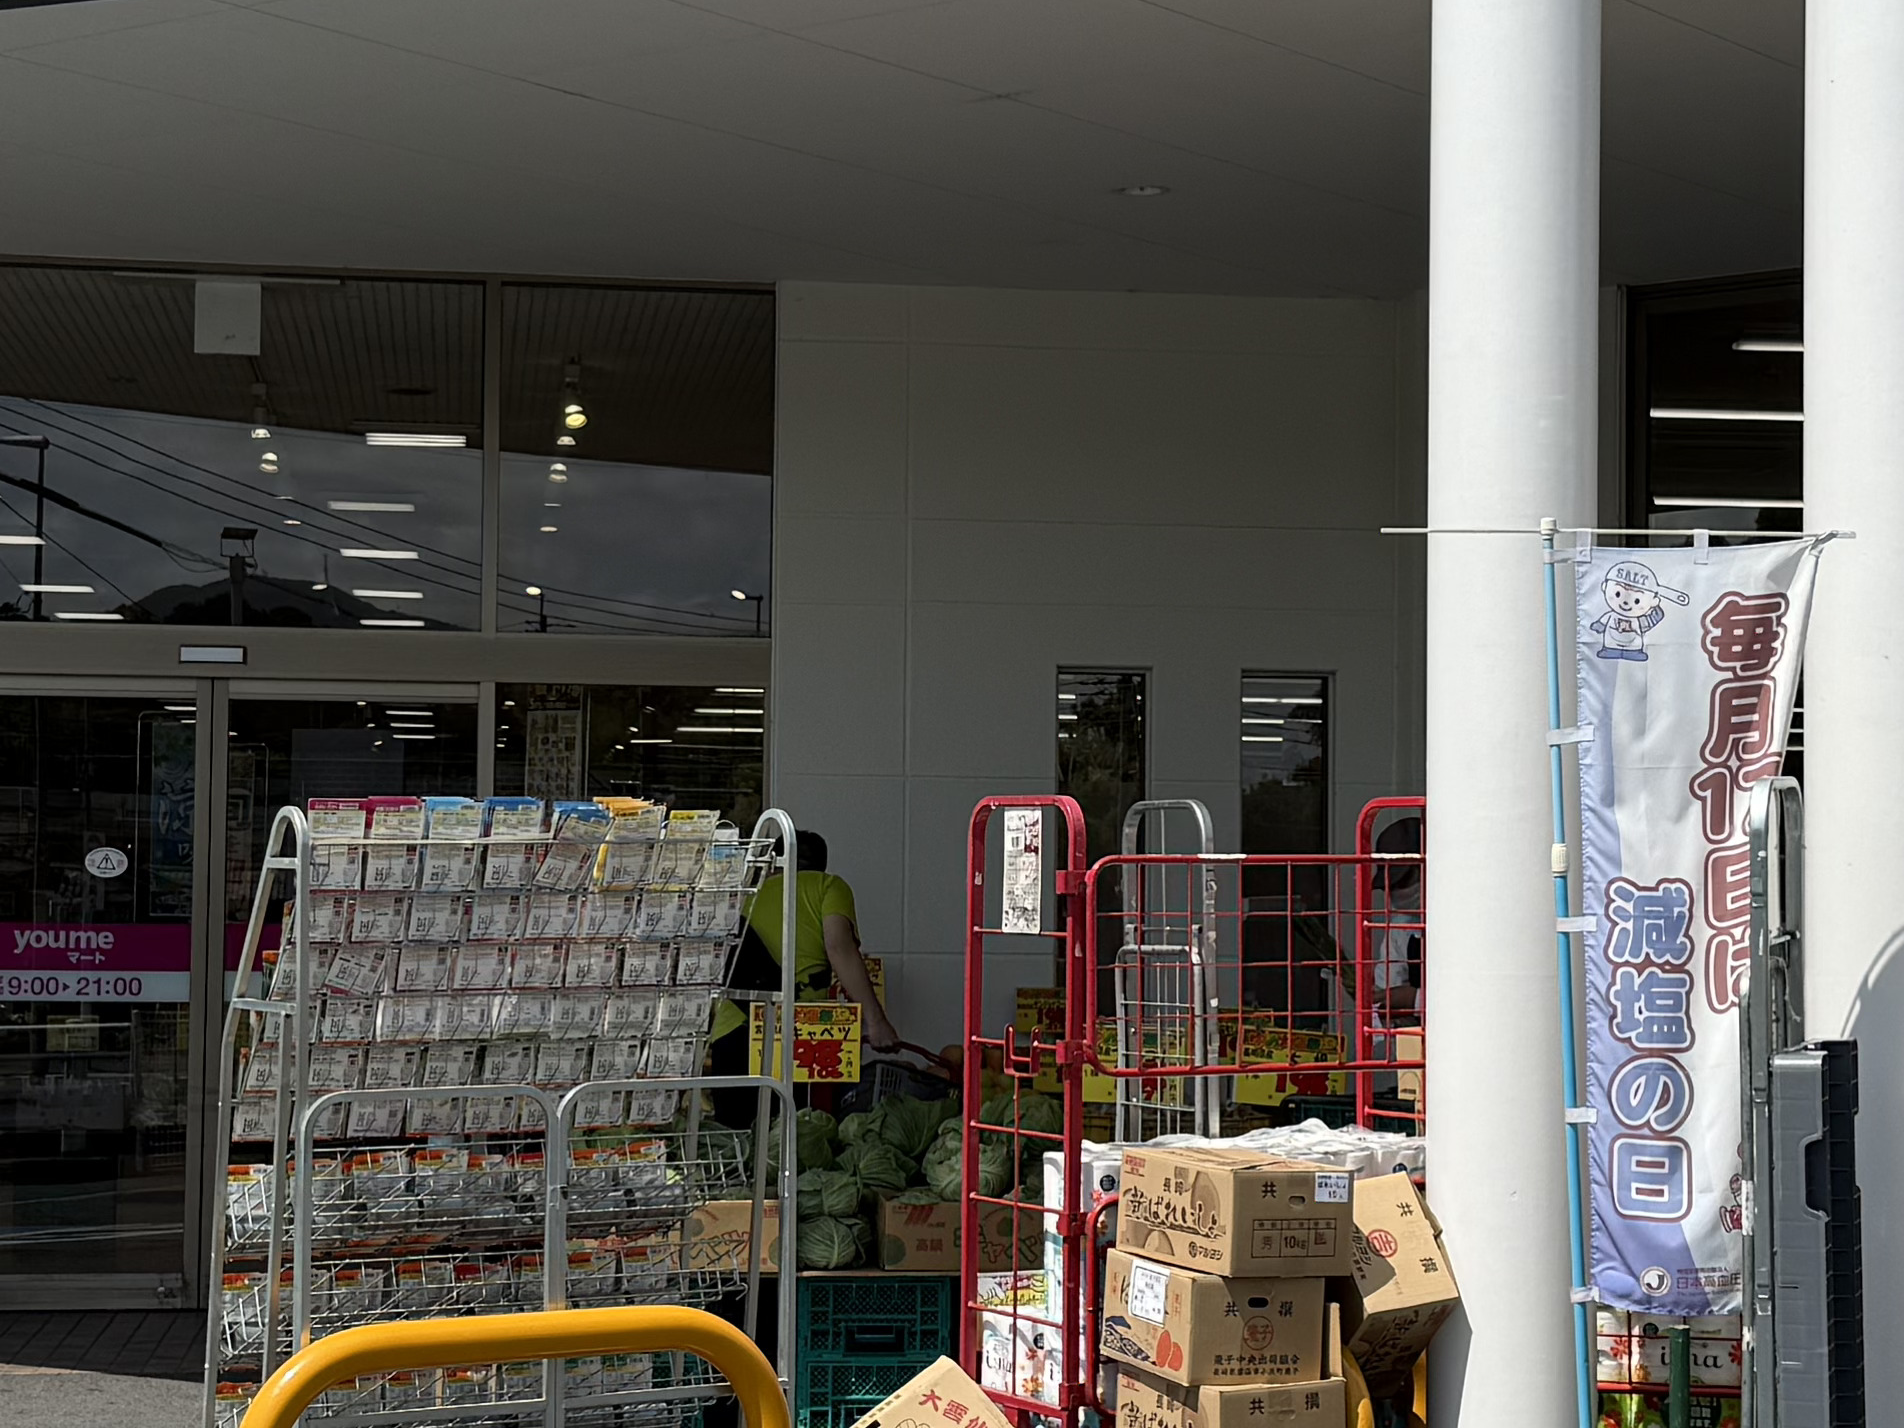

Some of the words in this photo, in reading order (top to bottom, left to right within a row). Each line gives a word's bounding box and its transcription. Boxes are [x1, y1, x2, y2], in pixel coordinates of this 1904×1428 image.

[1615, 568, 1650, 585] SALT
[13, 929, 115, 954] youme
[66, 952, 106, 965] マート
[7, 976, 60, 996] 9:00
[75, 977, 143, 997] 21:00
[1603, 876, 1696, 1223] 減塩の日
[1261, 1181, 1278, 1200] 共
[1223, 1301, 1240, 1318] 共
[1248, 1397, 1265, 1417] 共
